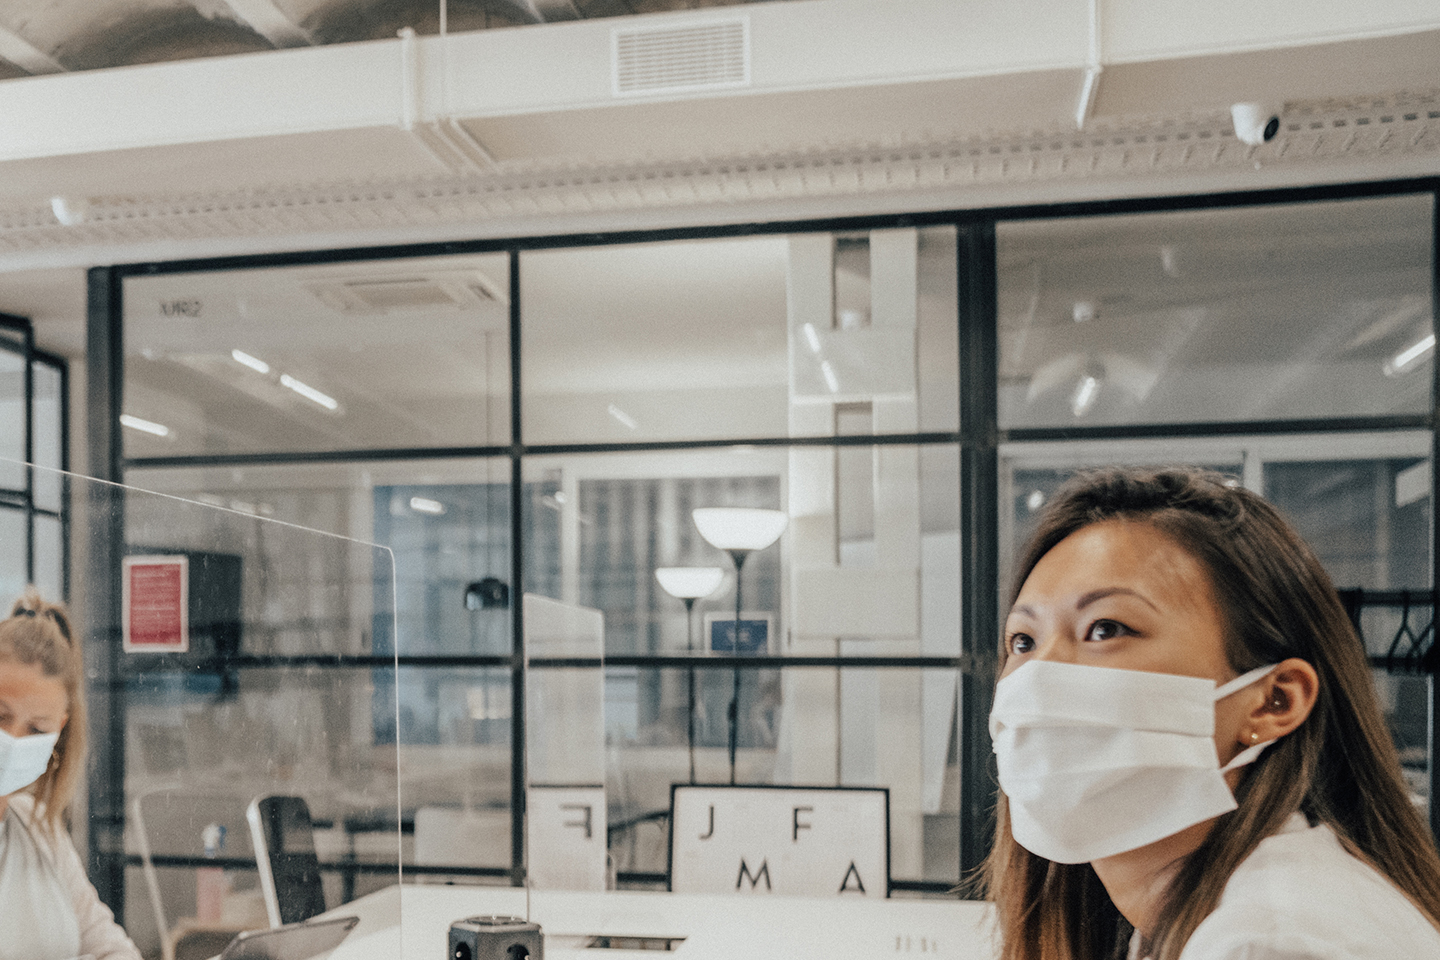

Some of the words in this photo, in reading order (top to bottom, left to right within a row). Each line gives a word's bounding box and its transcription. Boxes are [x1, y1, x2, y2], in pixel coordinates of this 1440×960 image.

[699, 804, 715, 840] J
[793, 805, 814, 842] F
[736, 858, 772, 891] M
[839, 861, 866, 894] A
